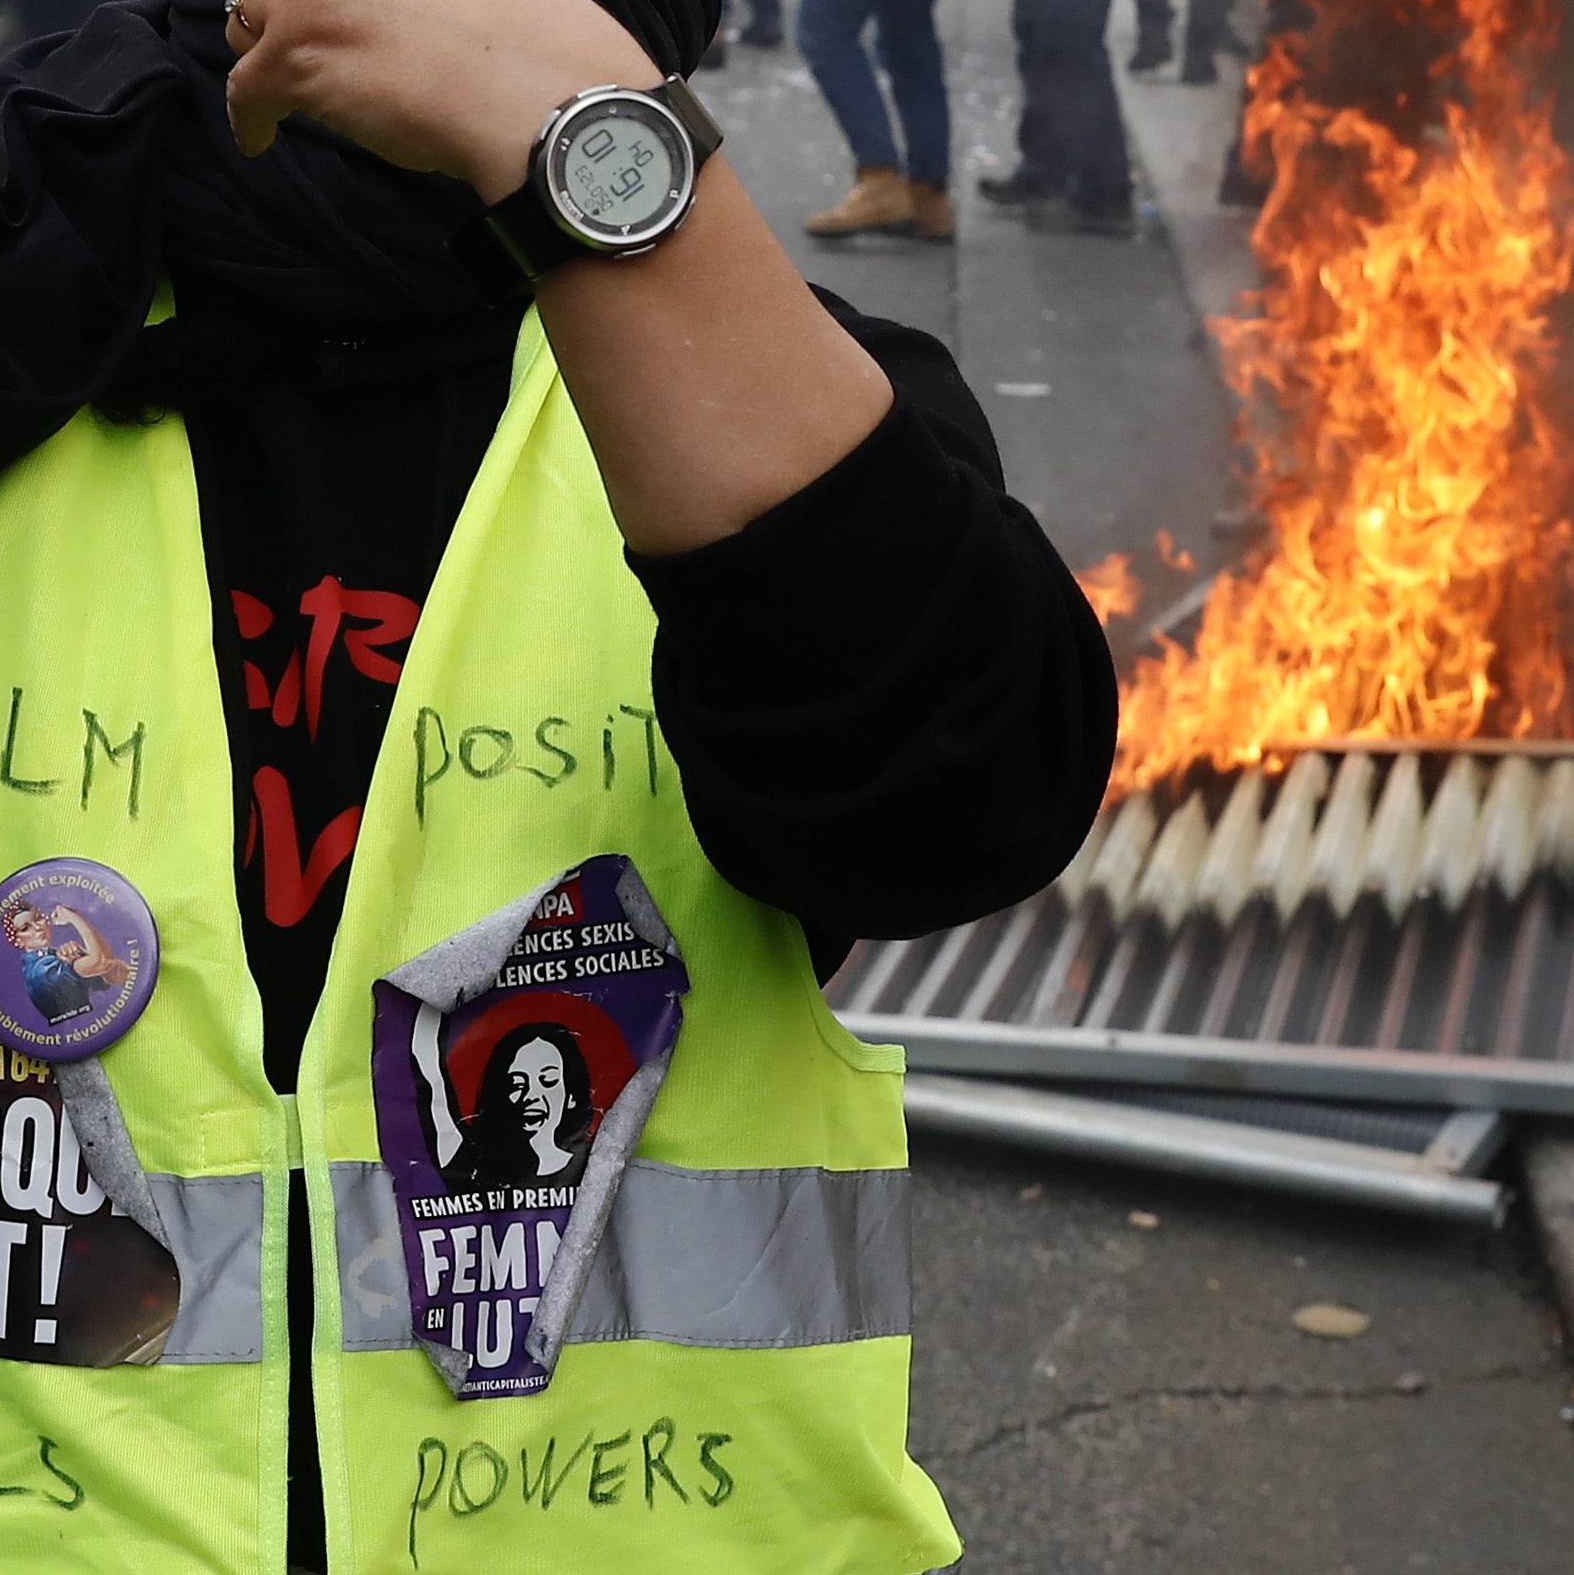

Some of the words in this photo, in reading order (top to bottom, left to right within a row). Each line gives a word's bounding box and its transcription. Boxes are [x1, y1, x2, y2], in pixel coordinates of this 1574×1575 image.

[49, 874, 116, 905] exploitée
[509, 928, 574, 958] ENCES
[581, 921, 635, 947] SEXIS
[496, 960, 568, 988] LENCES
[574, 948, 665, 979] SOCIALES
[66, 950, 141, 1044] révolutionnaire
[10, 1049, 50, 1084] 64
[411, 1192, 483, 1218] FEMMES
[487, 1190, 505, 1210] EN
[513, 1186, 580, 1210] PREMI
[427, 1308, 445, 1329] EN
[408, 1415, 735, 1569] POWERS
